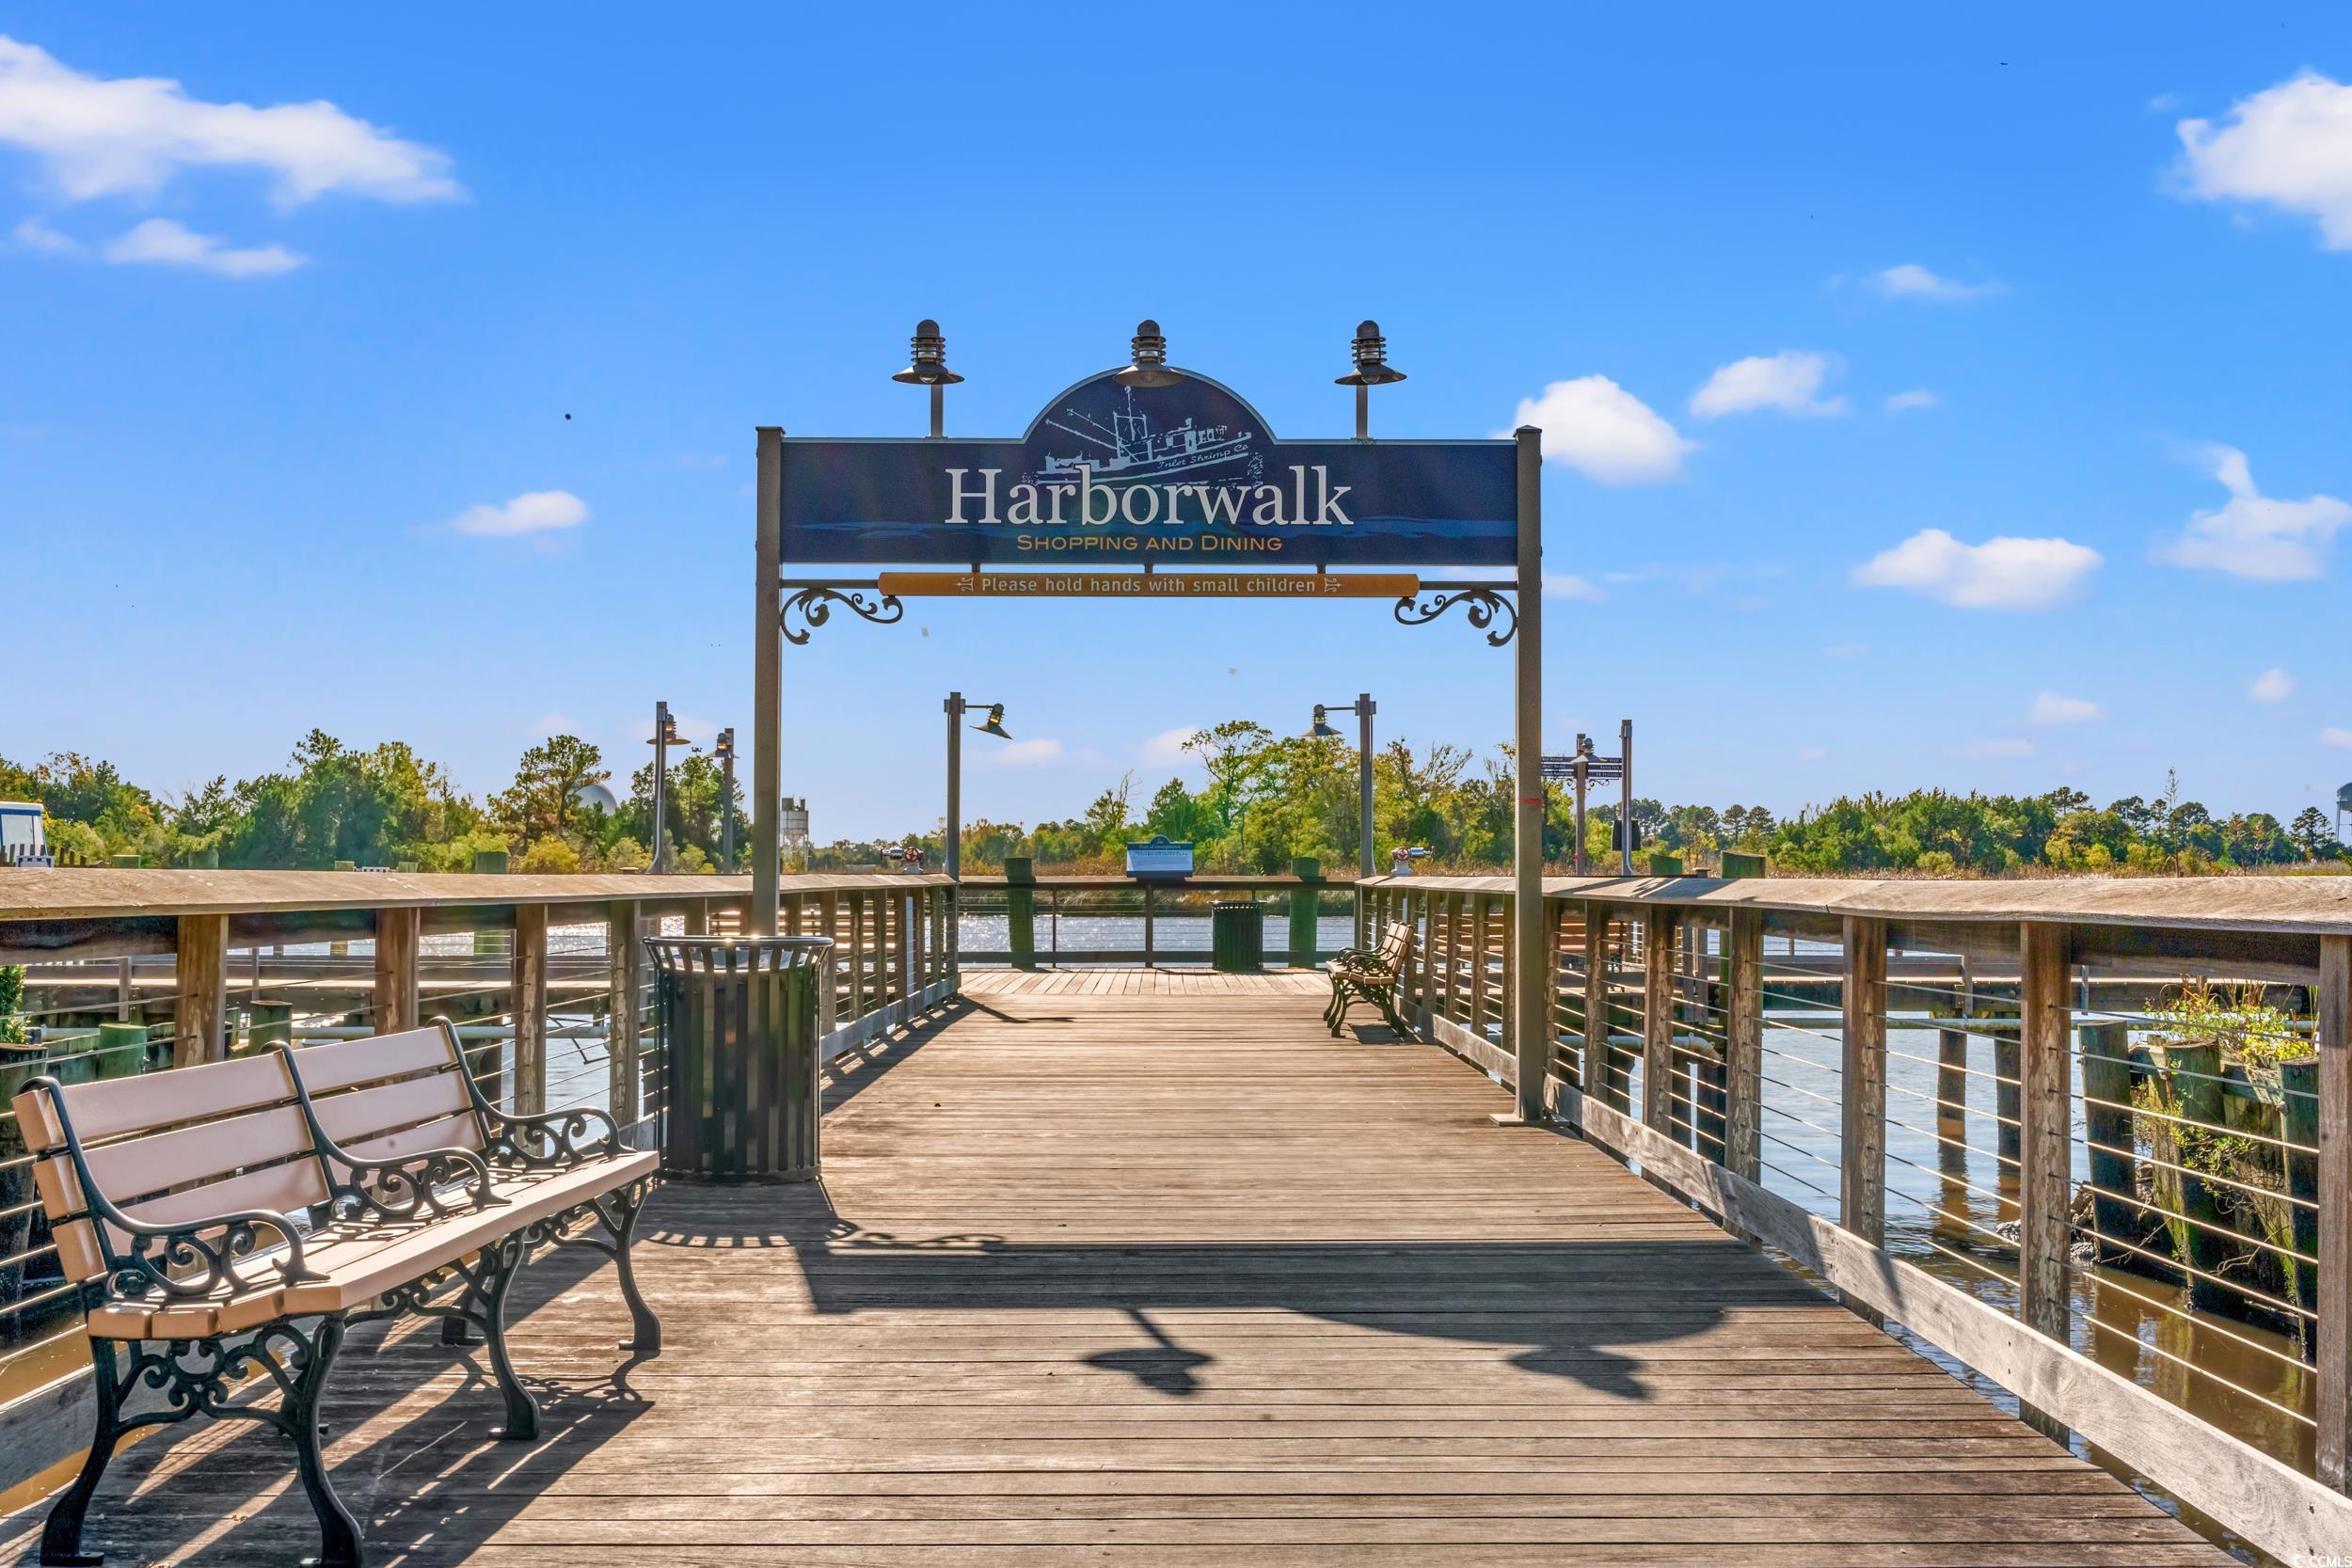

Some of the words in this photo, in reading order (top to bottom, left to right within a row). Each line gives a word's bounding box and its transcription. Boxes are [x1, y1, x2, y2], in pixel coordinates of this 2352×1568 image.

[1157, 458, 1186, 469] Inlet
[1189, 450, 1232, 464] Shrimp
[1233, 444, 1249, 452] Co
[944, 465, 1355, 526] Harborwalk
[1017, 534, 1138, 551] SHOPPING
[1145, 536, 1194, 551] AND
[1201, 534, 1283, 551] DINING
[981, 577, 1038, 593] Please
[1045, 577, 1083, 593] hold
[1090, 577, 1141, 593] hands
[1149, 577, 1185, 593] with
[1192, 577, 1239, 593] small
[1247, 577, 1315, 593] children
